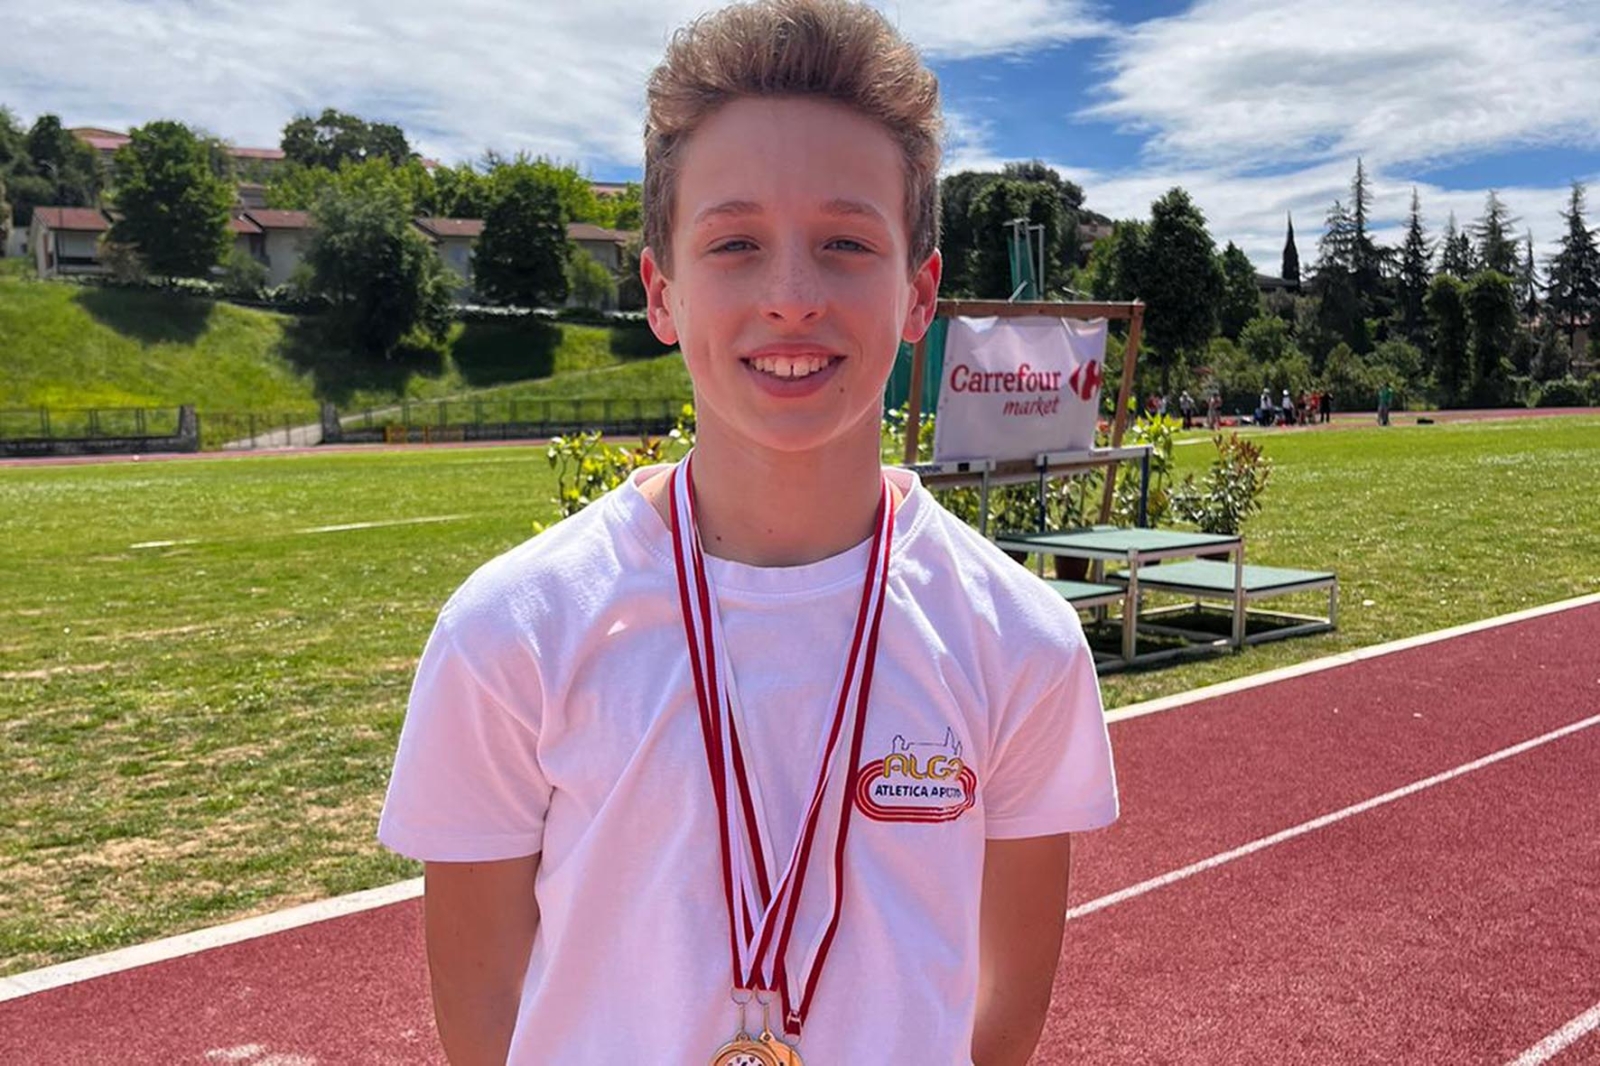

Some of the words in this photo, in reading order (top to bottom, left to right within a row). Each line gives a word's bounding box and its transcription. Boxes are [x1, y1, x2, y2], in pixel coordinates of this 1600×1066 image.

[950, 364, 1061, 392] Carrefour
[1003, 397, 1060, 416] market
[875, 785, 928, 797] ATLETICA
